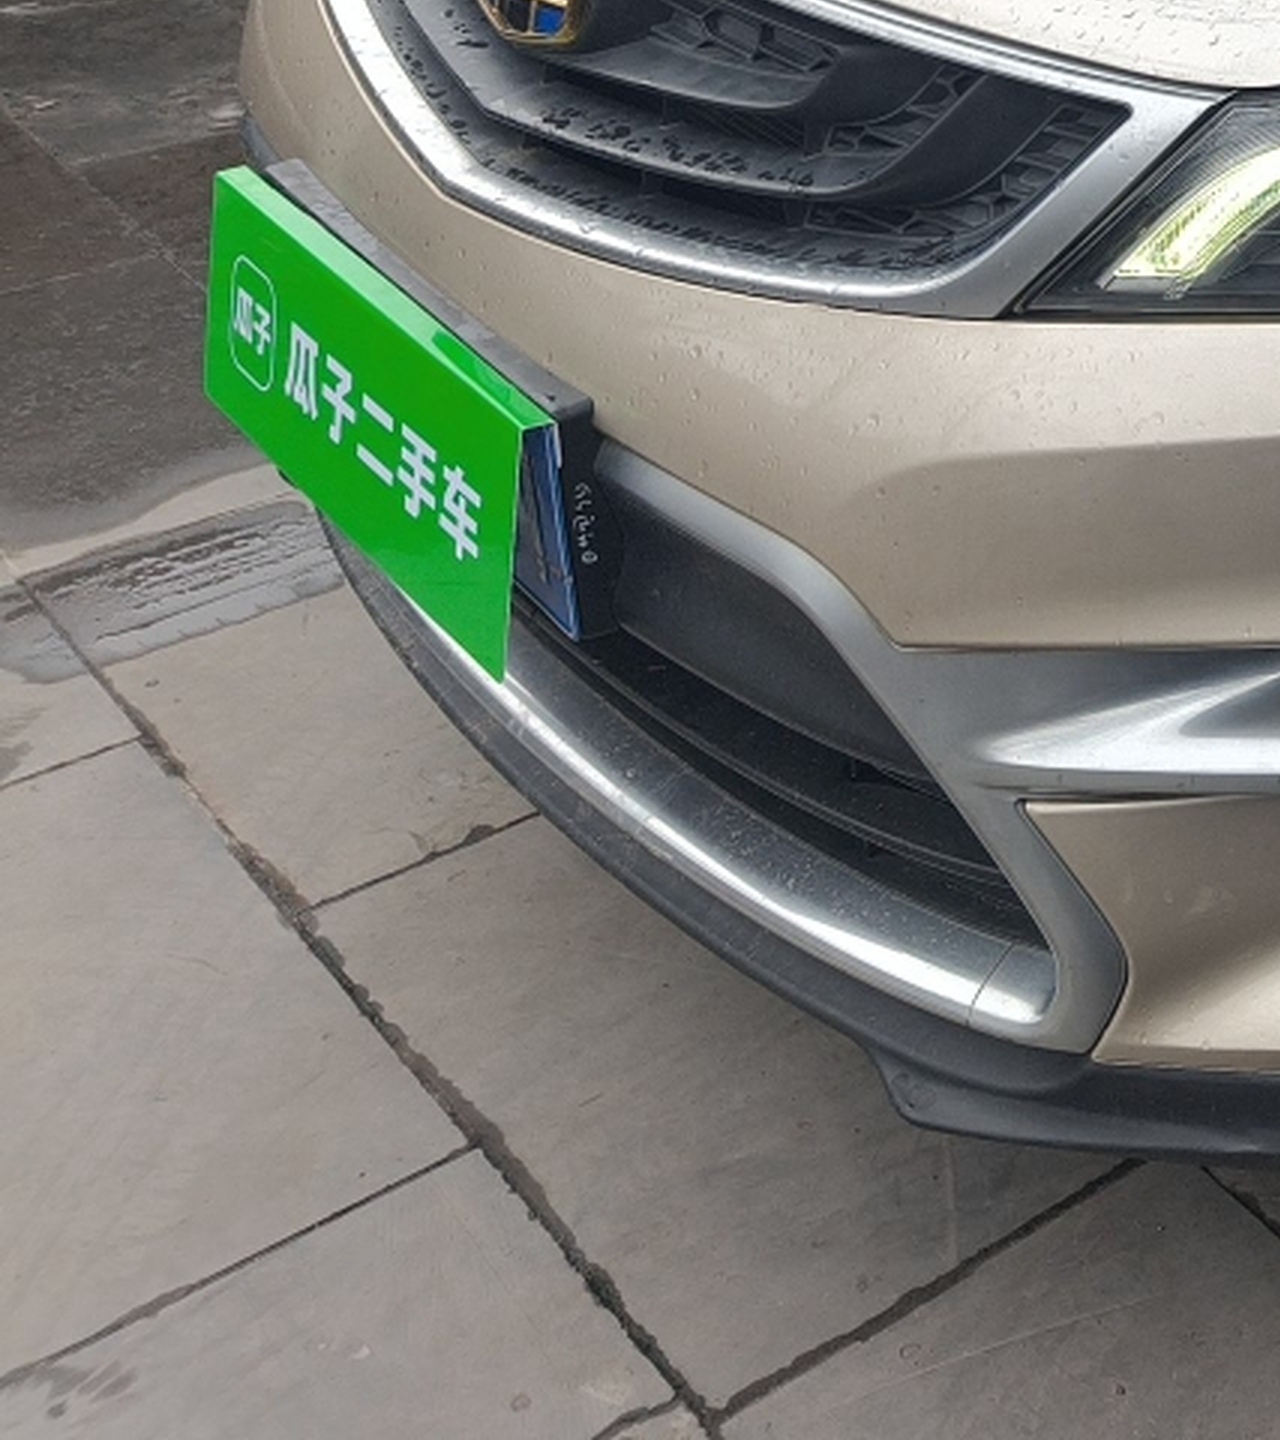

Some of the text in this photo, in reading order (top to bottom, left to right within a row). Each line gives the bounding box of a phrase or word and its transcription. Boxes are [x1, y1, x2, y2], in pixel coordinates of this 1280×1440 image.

[234, 285, 271, 355] 瓜子
[284, 320, 482, 562] 瓜子二手车
